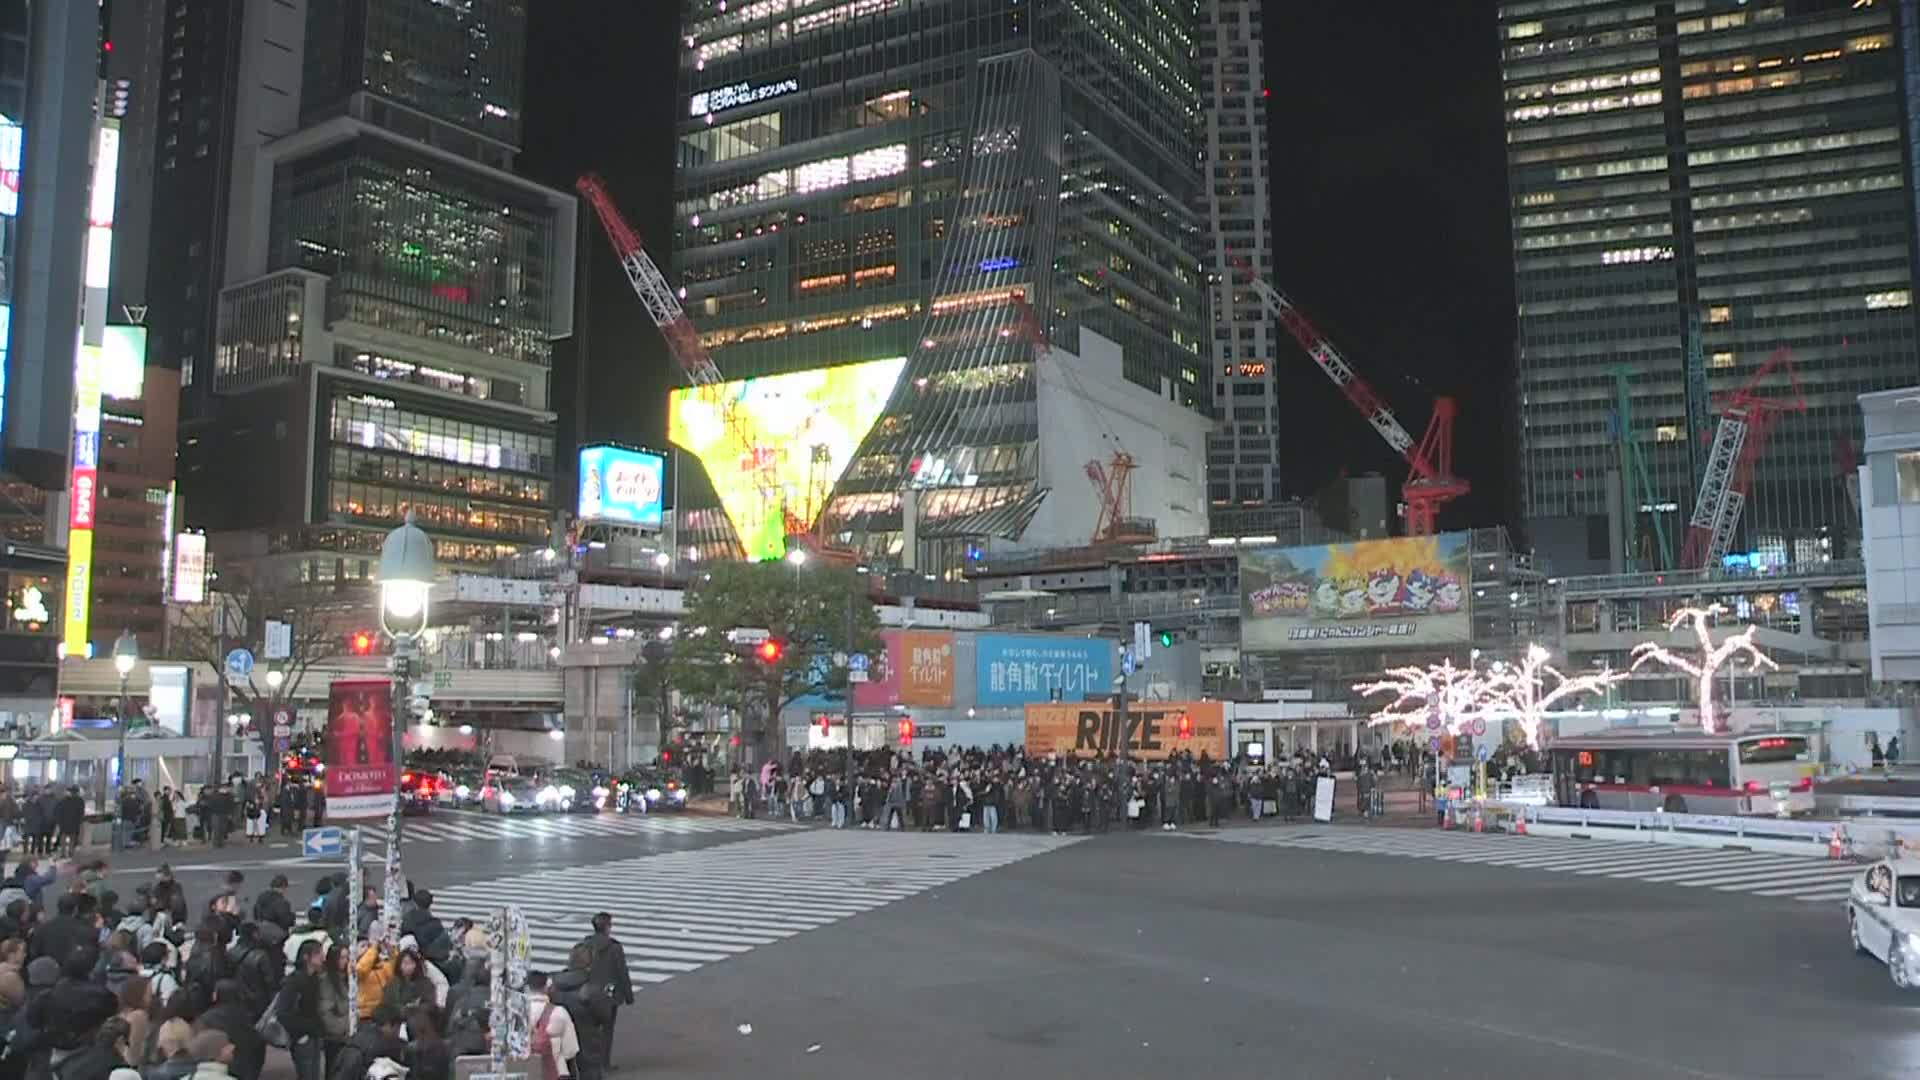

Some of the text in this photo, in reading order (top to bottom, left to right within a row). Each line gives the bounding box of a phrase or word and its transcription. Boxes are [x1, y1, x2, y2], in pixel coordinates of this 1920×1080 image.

[991, 662, 1098, 694] 龍角散ダイレクト
[1075, 711, 1164, 749] RIIZE
